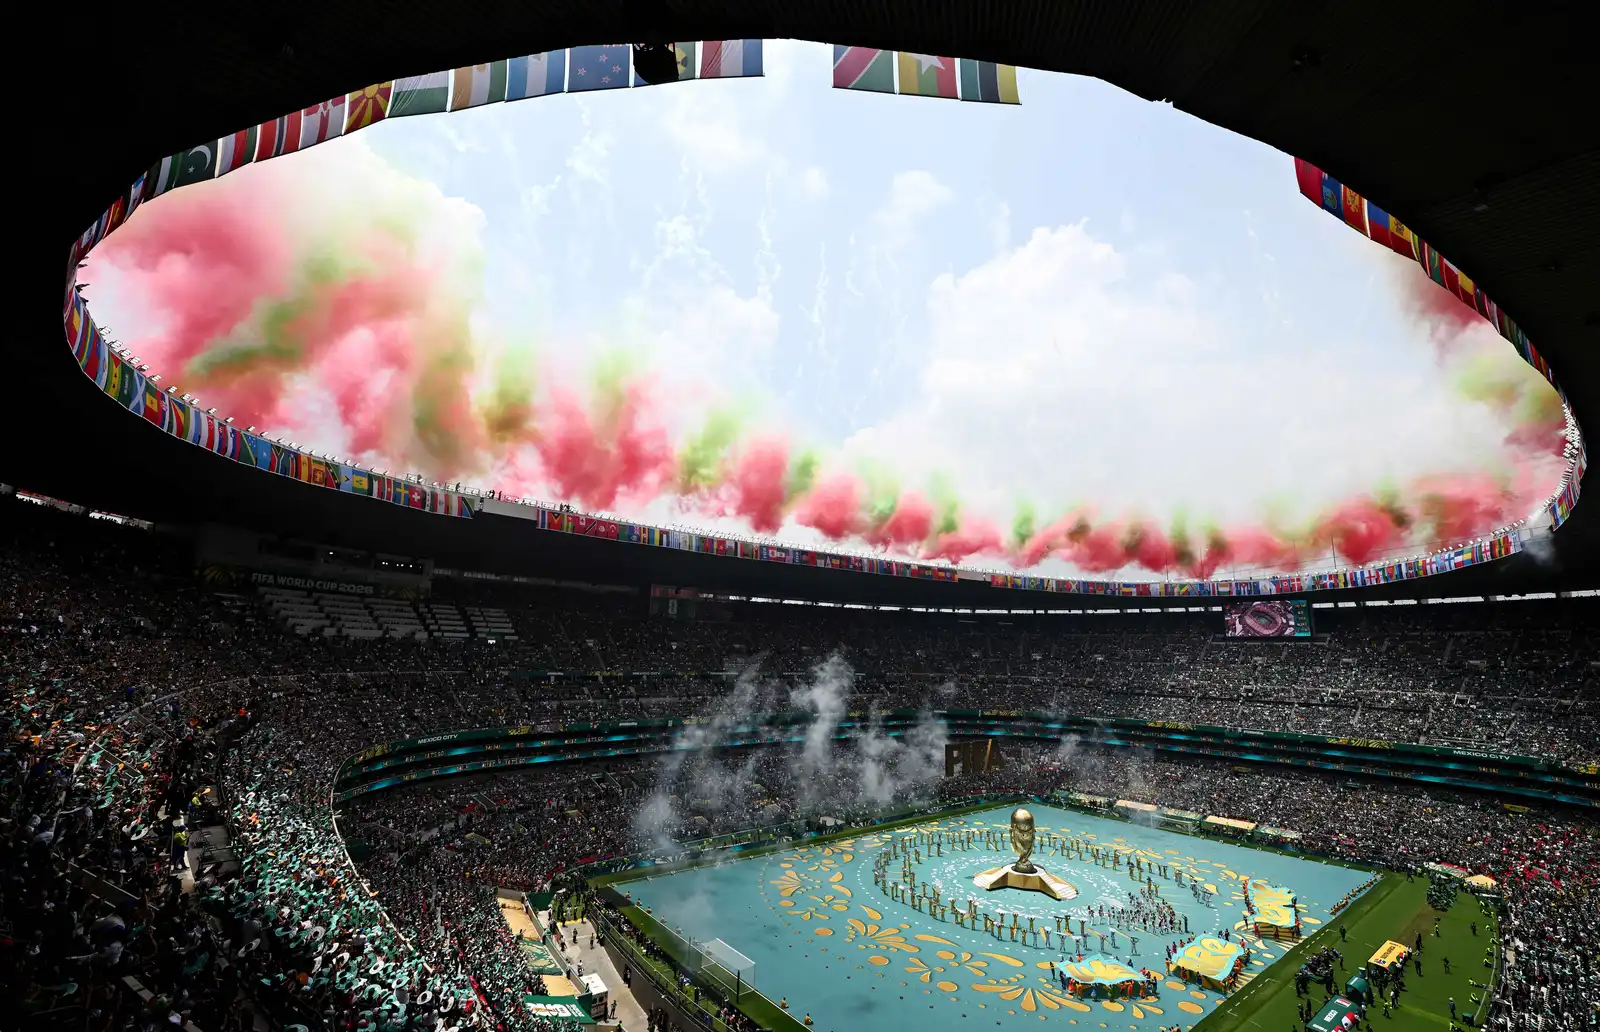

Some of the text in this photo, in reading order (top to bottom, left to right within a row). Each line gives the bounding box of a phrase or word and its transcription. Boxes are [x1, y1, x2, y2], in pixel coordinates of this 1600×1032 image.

[251, 572, 374, 594] FIFA WORLD CUP 2026
[417, 733, 458, 744] MEXICO CITY
[1453, 750, 1488, 758] MEXICO
